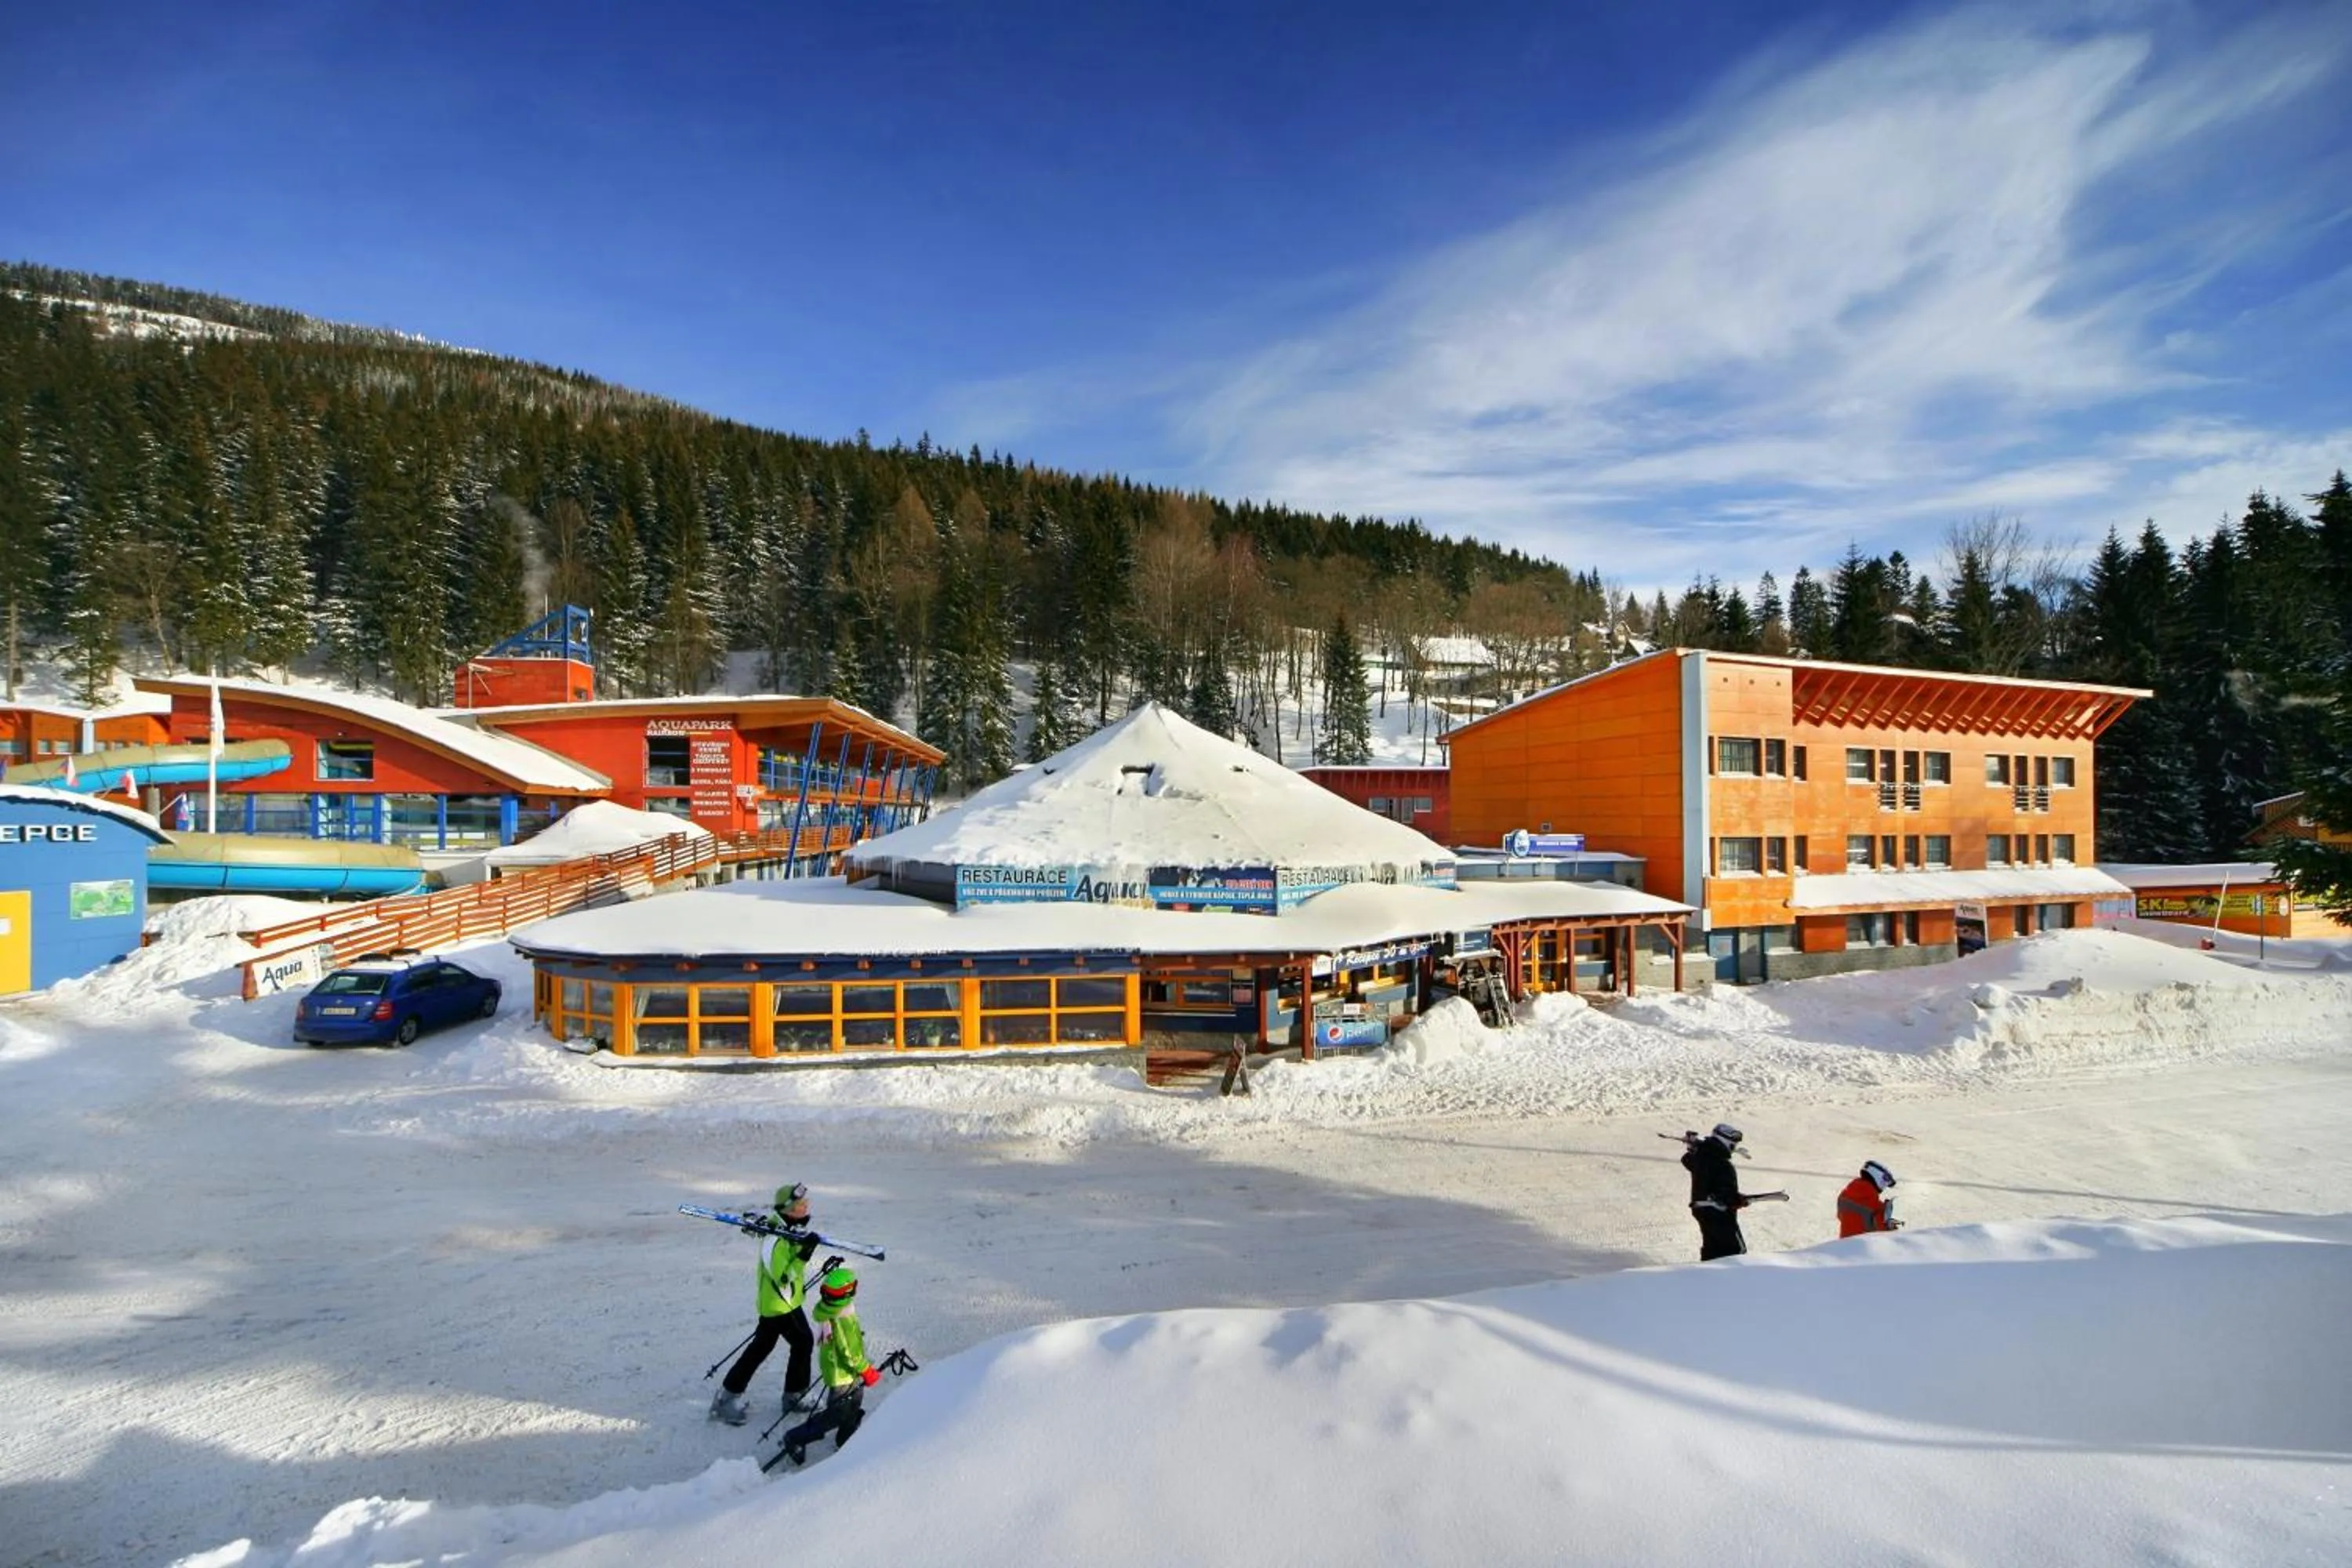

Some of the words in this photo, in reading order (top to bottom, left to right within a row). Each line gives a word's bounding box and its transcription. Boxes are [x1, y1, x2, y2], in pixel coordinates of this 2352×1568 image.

[647, 720, 733, 731] AQUAPARK
[962, 869, 1067, 884] RESTAURACE
[262, 960, 303, 991] Aqua
